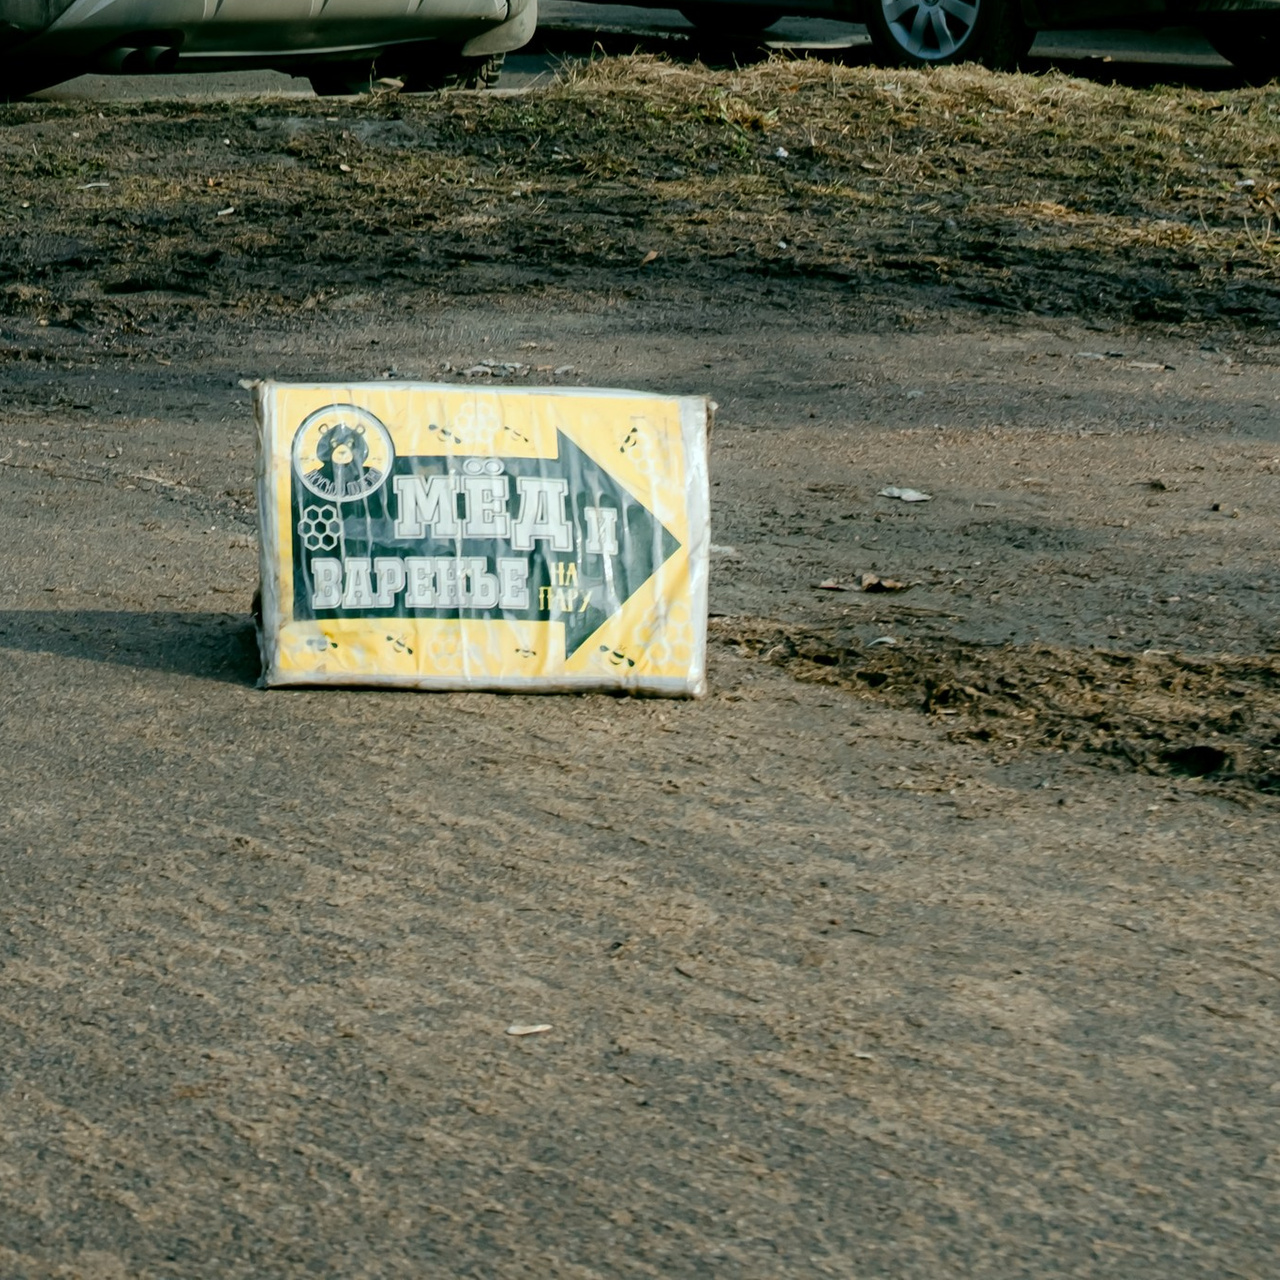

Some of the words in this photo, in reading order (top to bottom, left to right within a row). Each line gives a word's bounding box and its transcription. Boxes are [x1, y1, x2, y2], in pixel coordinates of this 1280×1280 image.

[393, 458, 573, 551] МЁД
[584, 506, 618, 555] И
[311, 556, 529, 610] ВАРЕНЬЕ
[550, 561, 578, 588] НА
[539, 586, 592, 613] ПАРУ
